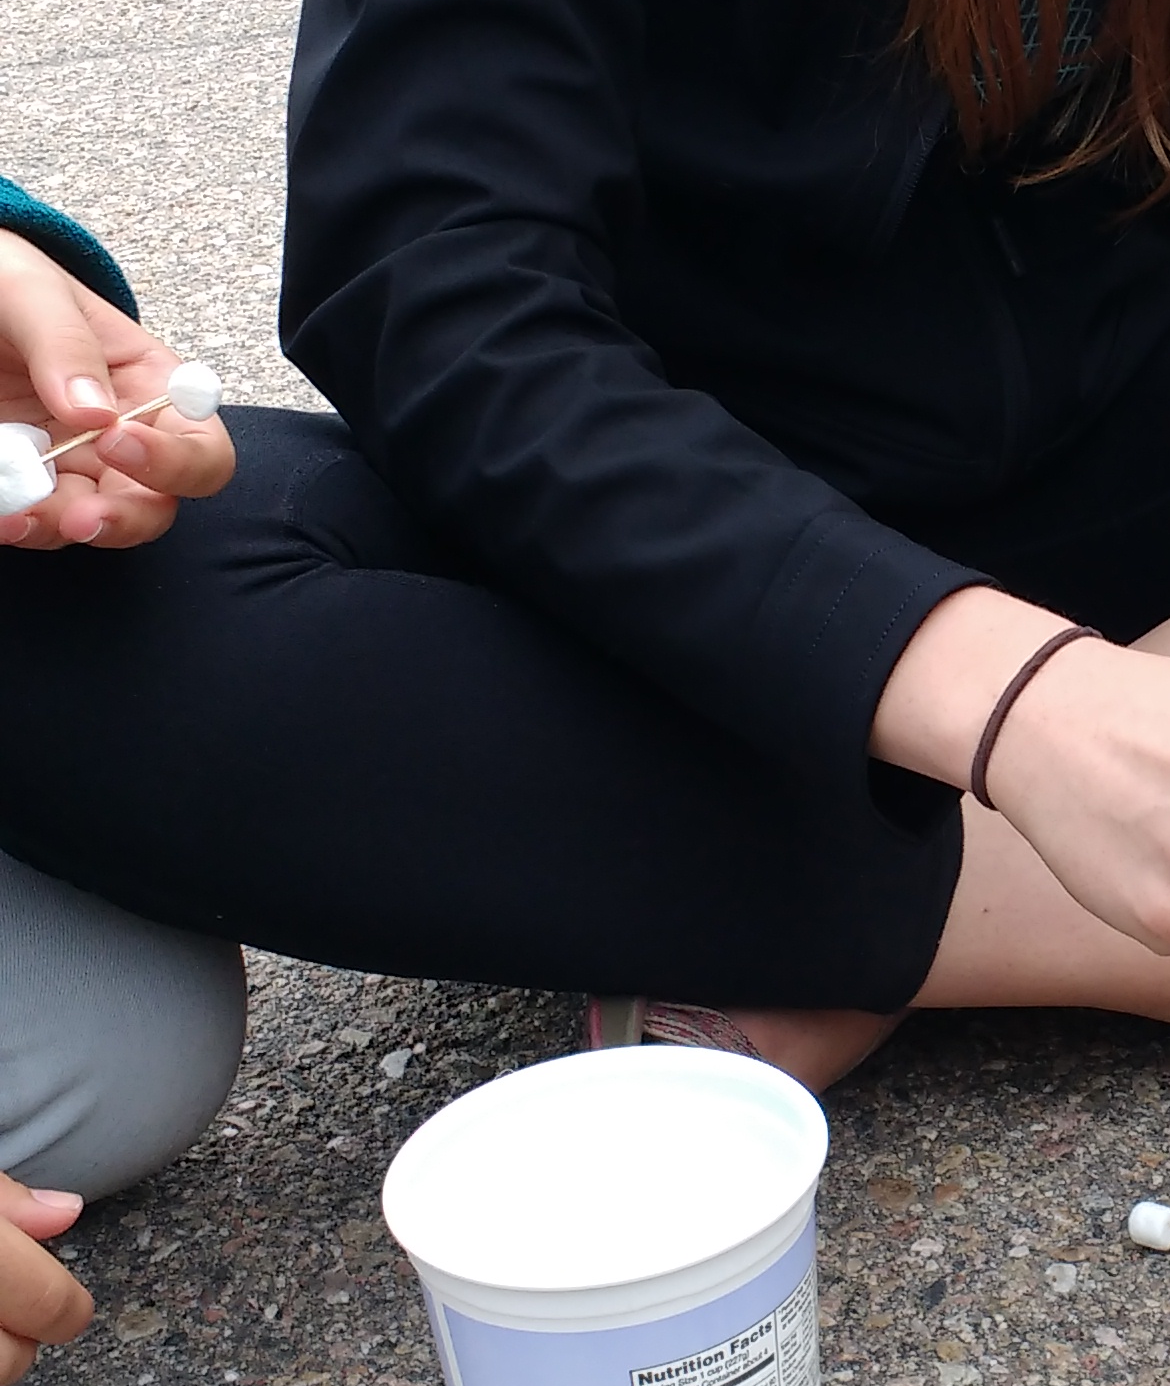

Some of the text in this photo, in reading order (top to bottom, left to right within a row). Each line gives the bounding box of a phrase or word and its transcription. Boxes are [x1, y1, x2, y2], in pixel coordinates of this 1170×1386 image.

[638, 1321, 773, 1386] Nutrition Facts
[678, 1376, 698, 1386] Size
[707, 1365, 724, 1377] cup
[725, 1350, 750, 1370] (227g)
[743, 1351, 763, 1369] about
